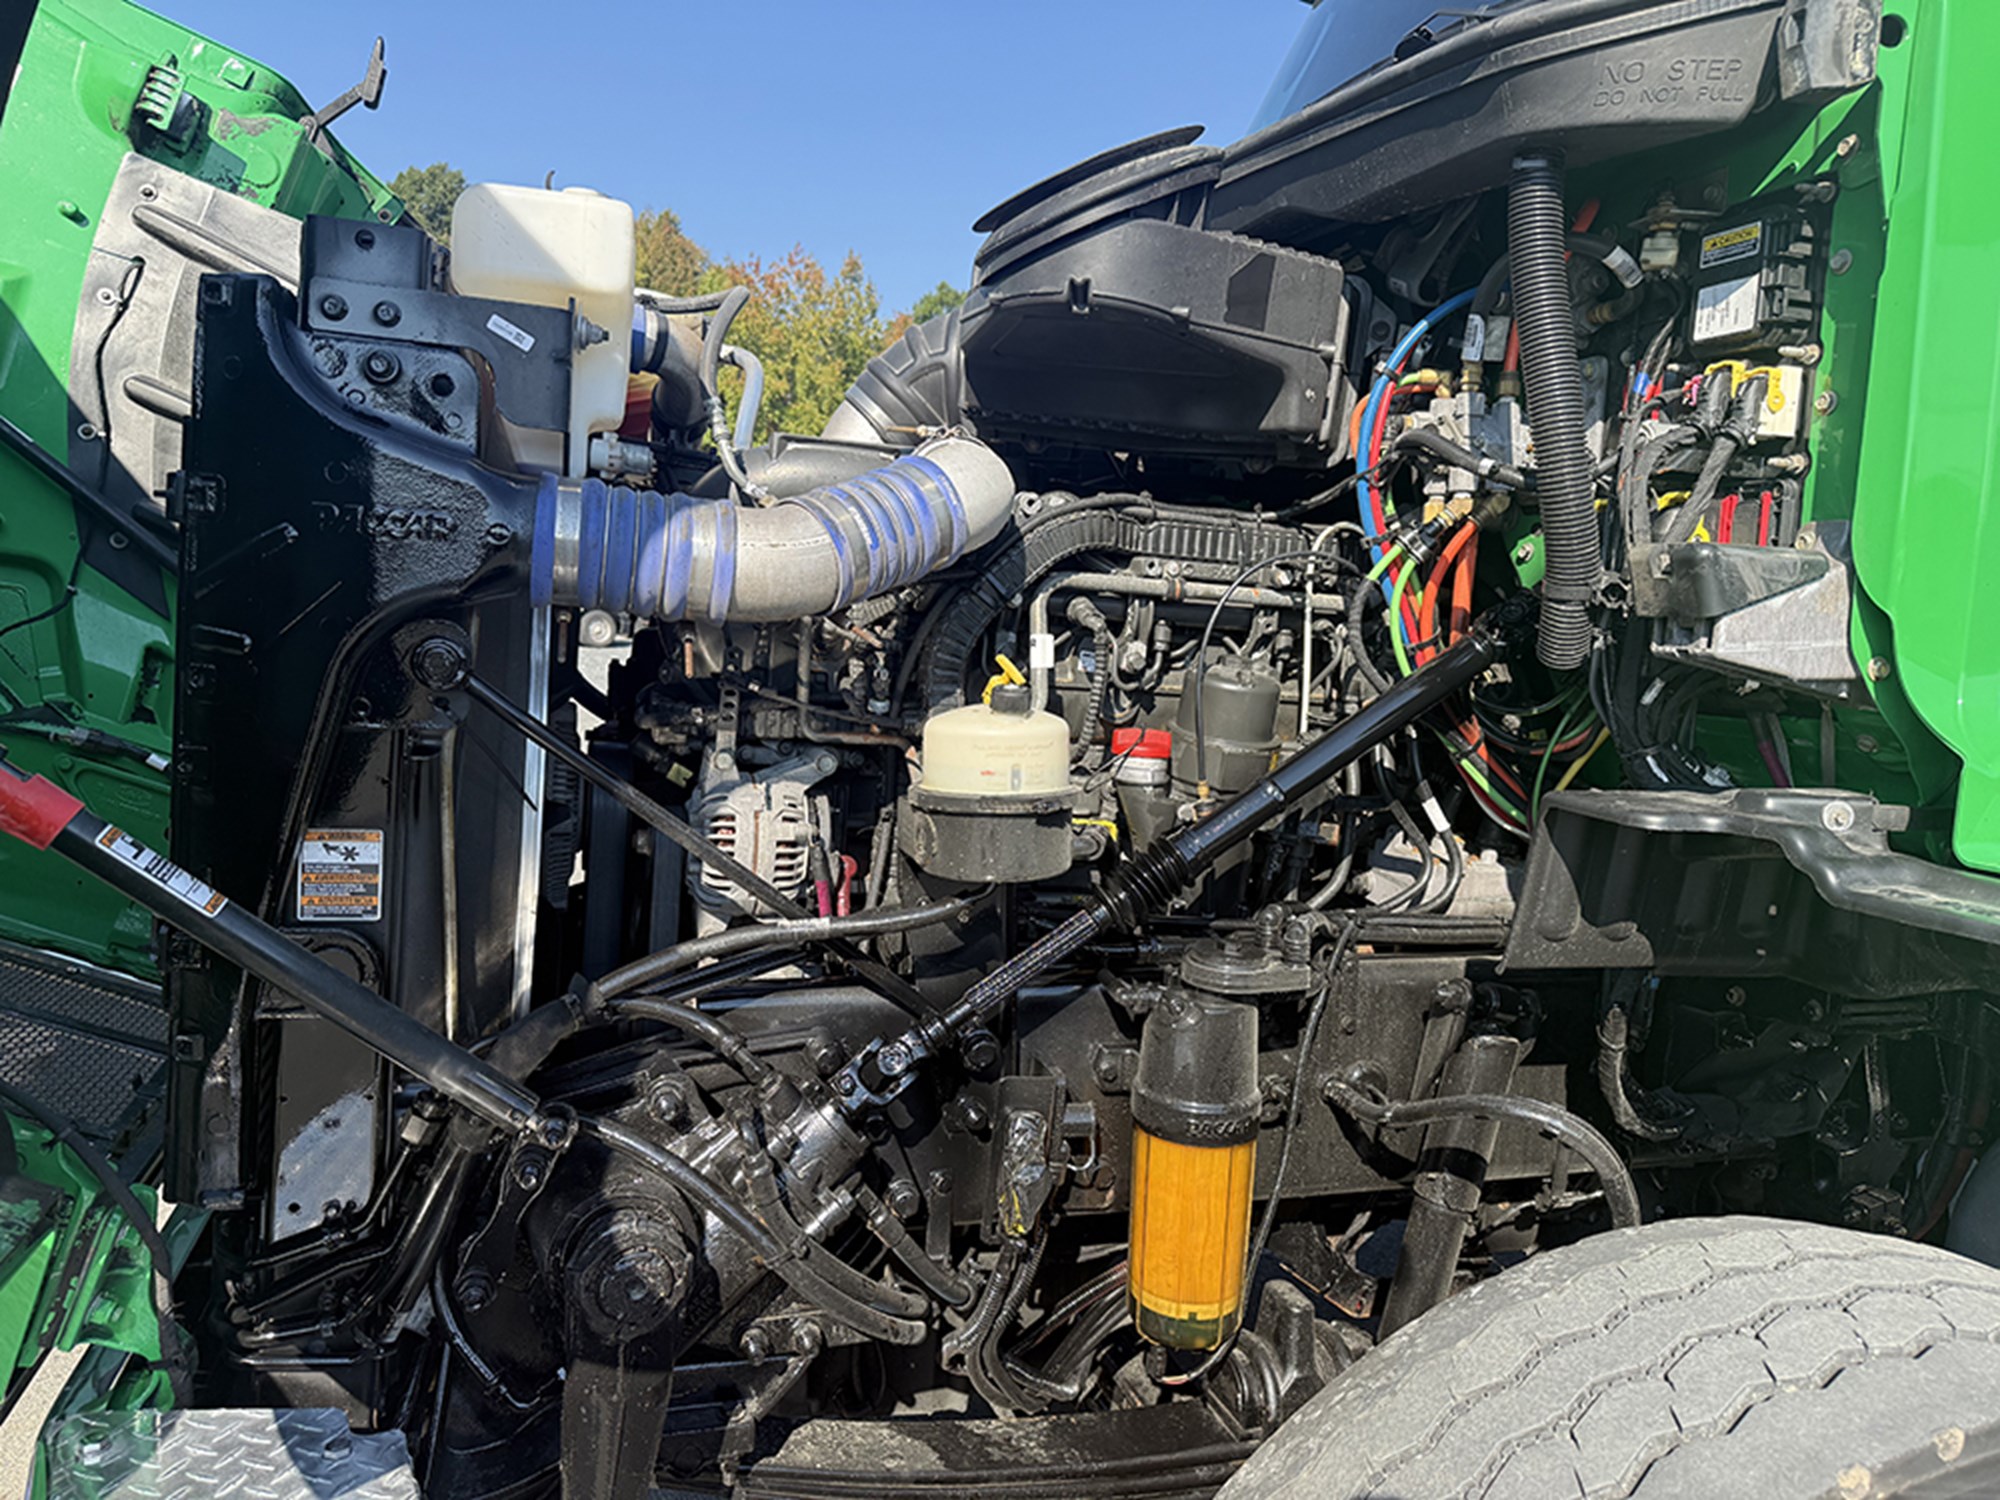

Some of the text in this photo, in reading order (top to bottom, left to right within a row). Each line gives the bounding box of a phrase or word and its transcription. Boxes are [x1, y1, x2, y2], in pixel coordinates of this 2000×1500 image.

[1599, 59, 1743, 85] NO STEP
[1593, 89, 1625, 107] DO
[1640, 86, 1684, 103] NOT
